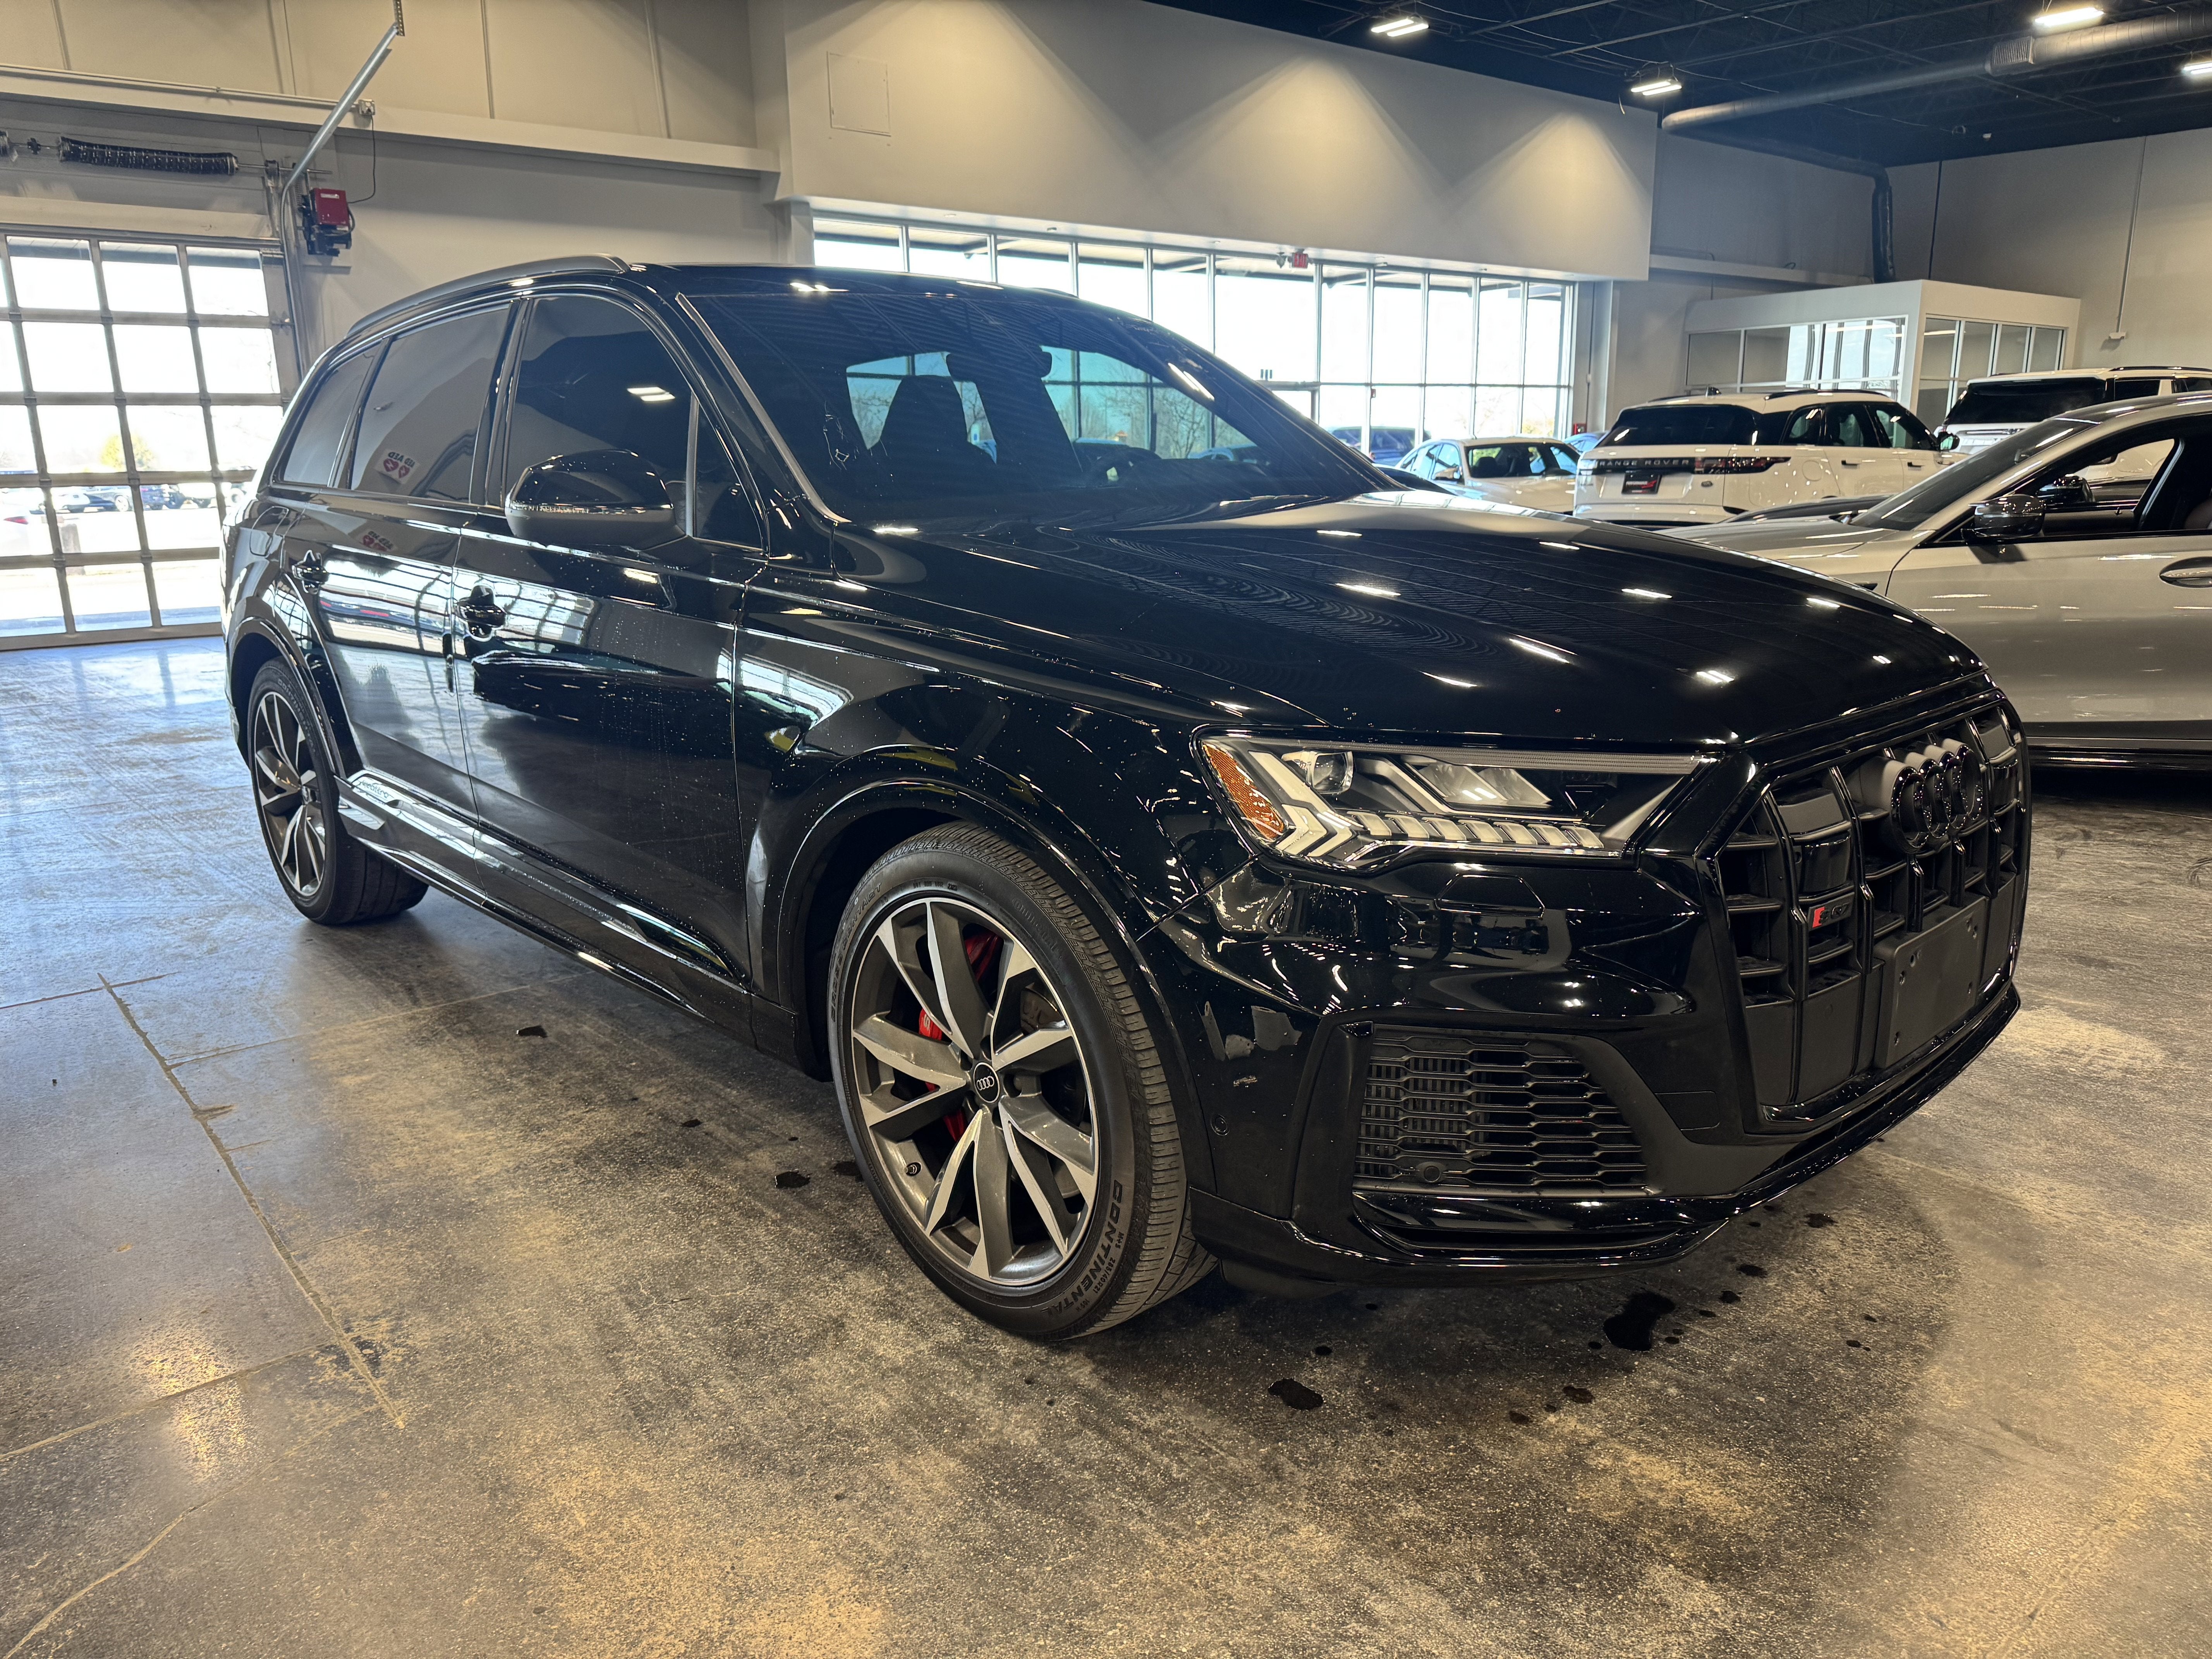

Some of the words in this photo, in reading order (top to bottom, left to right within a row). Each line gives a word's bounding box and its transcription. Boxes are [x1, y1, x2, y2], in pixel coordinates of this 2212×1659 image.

[842, 882, 882, 951] CONTACT
[1041, 1179, 1123, 1316] CONTINENTAL
[1115, 1231, 1124, 1249] M+S
[1093, 1257, 1116, 1293] 285/40R21
